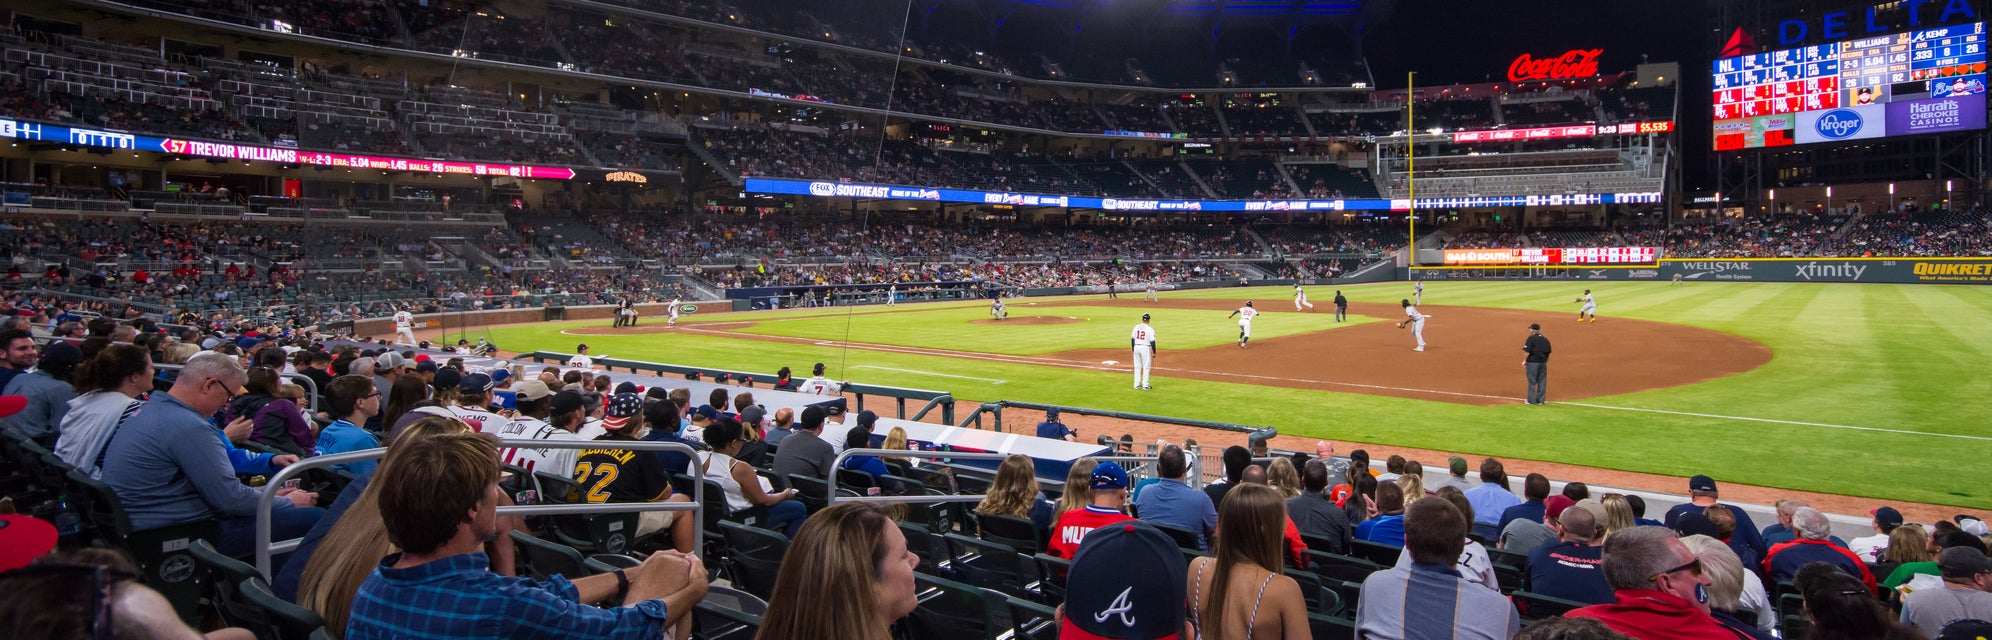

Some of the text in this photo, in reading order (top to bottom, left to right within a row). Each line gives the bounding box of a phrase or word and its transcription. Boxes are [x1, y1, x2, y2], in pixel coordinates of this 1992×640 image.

[1779, 0, 1977, 46] DELTA
[1926, 29, 1948, 39] KEMP
[1854, 37, 1890, 48] WILLIAMS
[1913, 44, 1979, 60] .333 8 26
[1507, 49, 1603, 82] Coca-Cola
[1719, 59, 1735, 72] NL
[1844, 54, 1907, 69] 2-3 5.04 1.45
[1846, 79, 1857, 88] 26
[1892, 73, 1904, 82] 82
[1720, 90, 1735, 103] AL
[1910, 100, 1959, 113] Harrah's
[1910, 109, 1959, 120] CHEROKEE
[1640, 122, 1668, 133] $5,535
[1820, 113, 1860, 136] Kroger
[1910, 117, 1959, 126] CASINOS
[1598, 126, 1616, 134] 9:28
[171, 140, 187, 153] 57
[189, 141, 235, 158] TREVOR
[237, 146, 296, 162] WILLIAMS
[316, 155, 331, 165] 2-3
[350, 157, 369, 168] 5.04
[390, 160, 407, 170] 1.45
[432, 163, 443, 172] 26
[488, 167, 508, 175] TOTAL:
[510, 167, 520, 176] 82
[816, 184, 830, 192] FOX
[836, 185, 889, 197] SOUTHEAST
[985, 193, 1002, 203] EVERY
[1024, 195, 1039, 205] GAME
[1117, 200, 1158, 210] SOUTHEAST
[1245, 202, 1265, 210] EVERY
[1289, 202, 1307, 210] GAME
[1447, 252, 1510, 261] GAS SOUTH
[1683, 262, 1749, 272] WELLSTAR
[1795, 261, 1866, 280] xfinity
[1136, 330, 1145, 340] 12
[815, 385, 823, 396] 7
[1095, 586, 1136, 627] A
